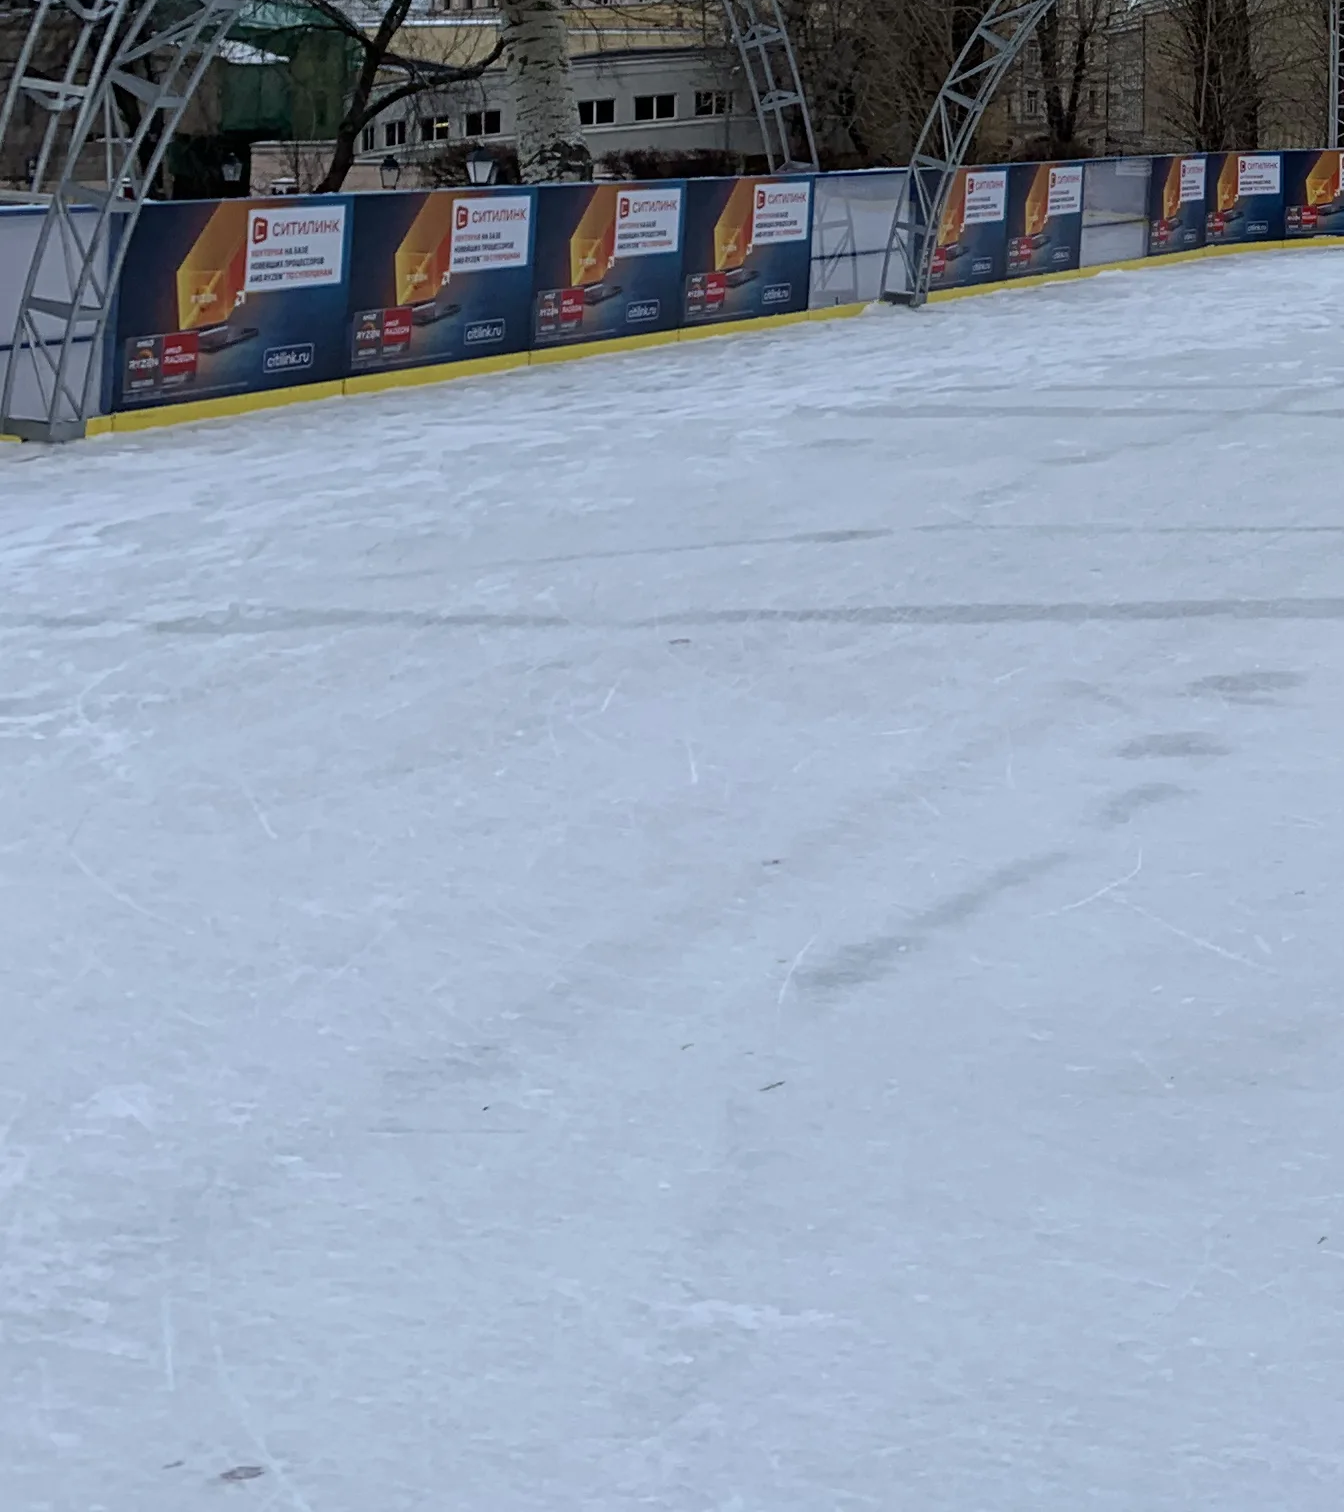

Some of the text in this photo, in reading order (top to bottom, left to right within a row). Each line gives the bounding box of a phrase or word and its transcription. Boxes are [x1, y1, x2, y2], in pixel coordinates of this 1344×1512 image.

[768, 192, 806, 205] СИТИЛИНК
[632, 200, 677, 214] СИТИЛИНК
[472, 208, 527, 224] СИТИЛИНК
[272, 219, 340, 236] СИТИЛИНК
[467, 327, 502, 340] citilink.ru
[267, 352, 310, 368] citilink.ru
